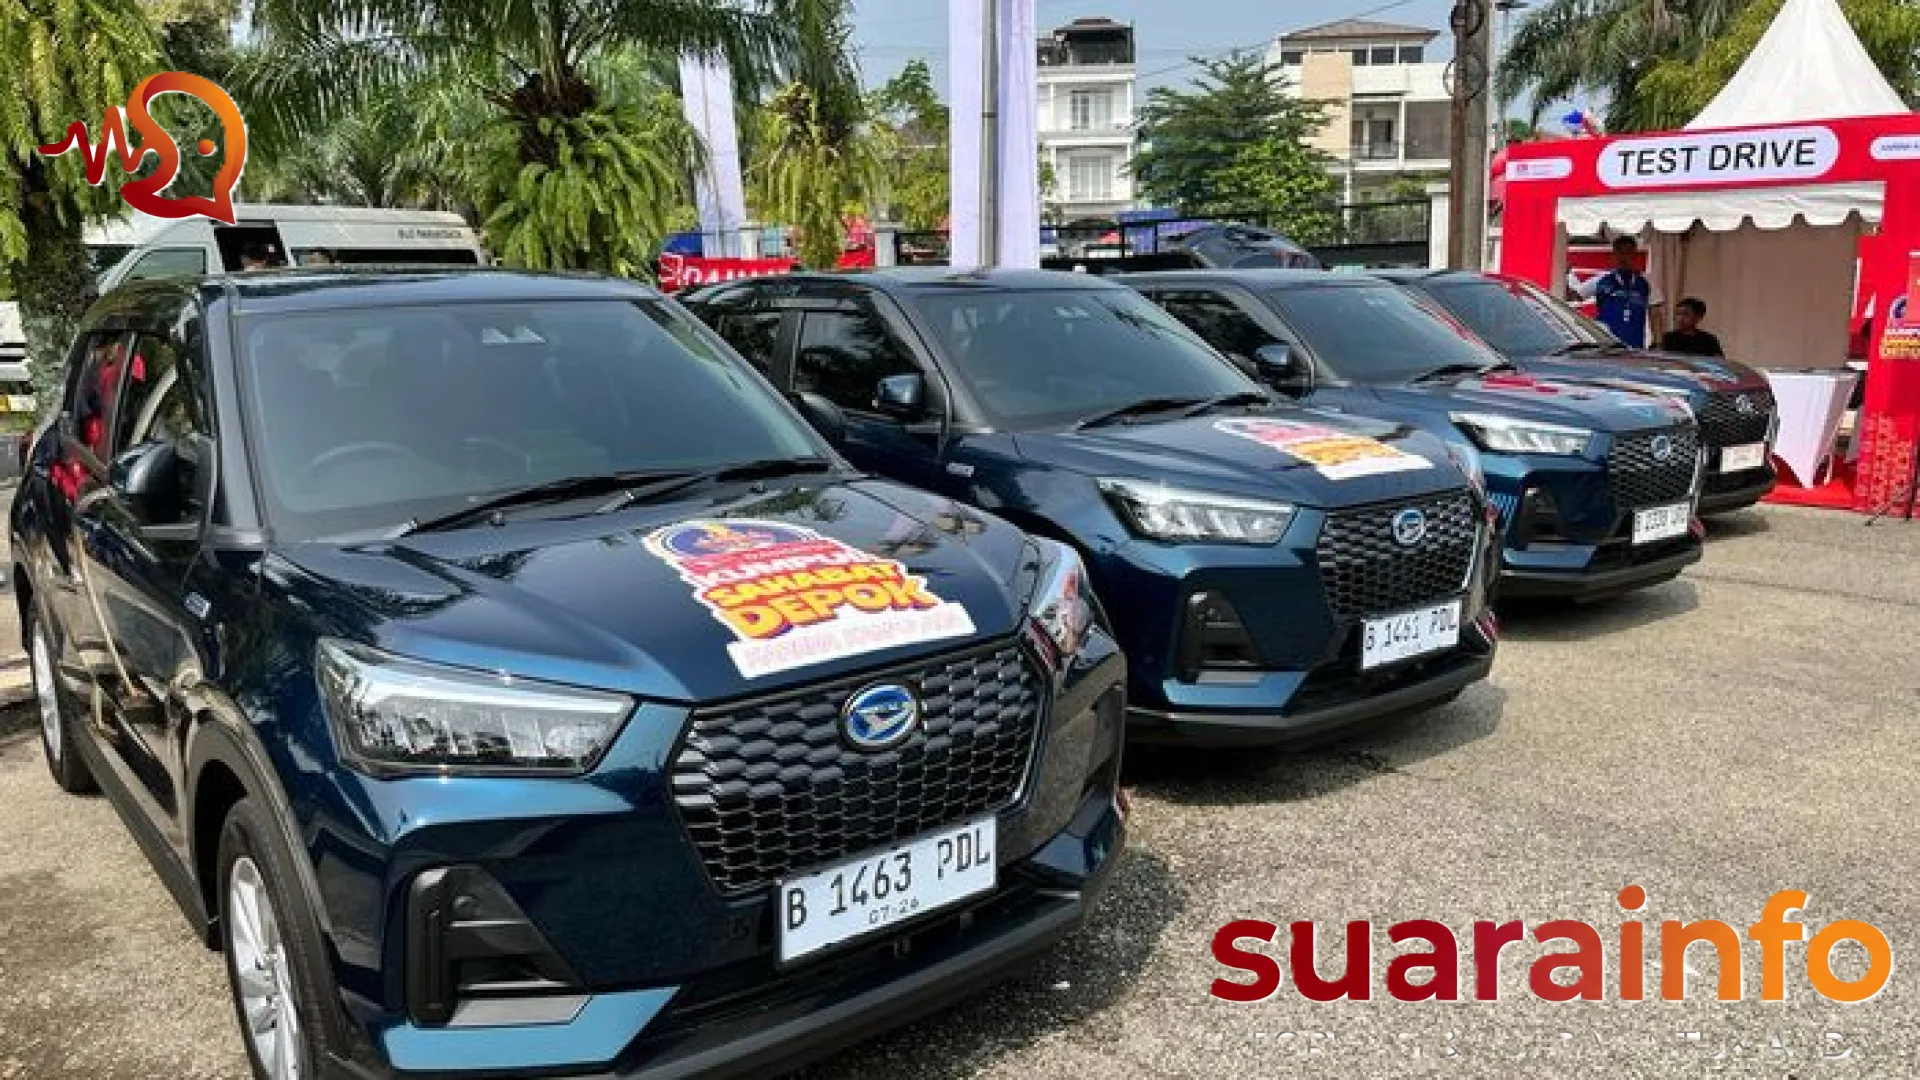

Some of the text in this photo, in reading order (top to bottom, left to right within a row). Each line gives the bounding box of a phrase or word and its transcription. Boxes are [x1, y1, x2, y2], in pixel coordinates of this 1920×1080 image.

[1617, 137, 1817, 176] TEST DRIVE
[702, 561, 906, 608] SAHABAT
[726, 577, 937, 639] DEPOK
[1366, 626, 1375, 651] B
[787, 828, 990, 932] B 1463 PDL
